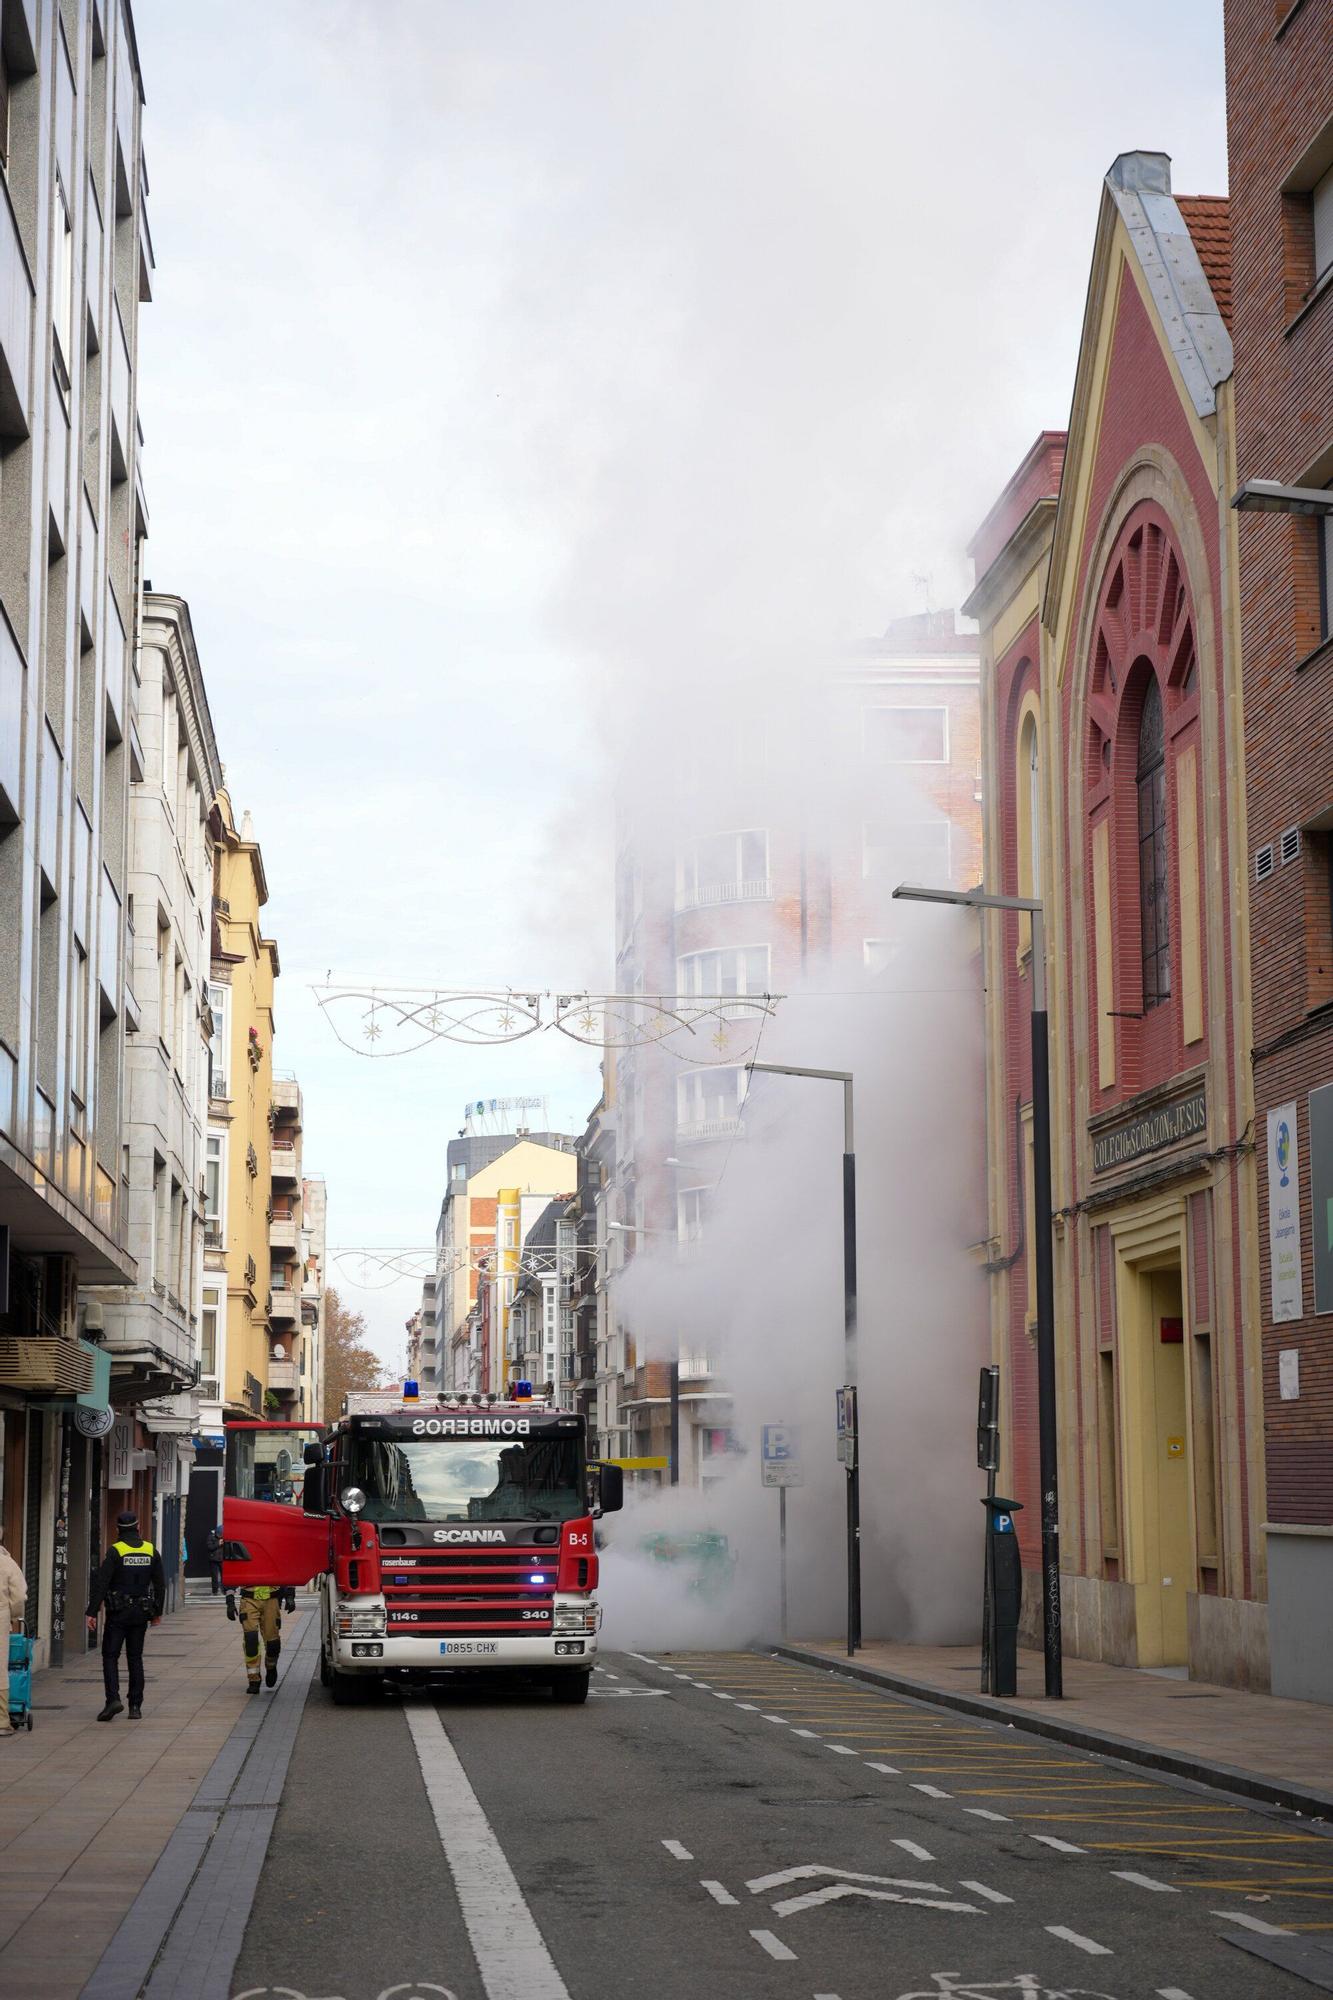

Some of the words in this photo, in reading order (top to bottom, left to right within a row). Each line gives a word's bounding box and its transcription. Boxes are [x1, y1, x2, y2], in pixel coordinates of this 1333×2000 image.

[1094, 1131, 1127, 1168] COLEGIO
[1174, 1097, 1205, 1136] JESUS
[999, 1515, 1010, 1531] P
[433, 1529, 506, 1543] SCANIA
[569, 1533, 588, 1546] B-5
[125, 1557, 150, 1565] POLIZIA
[382, 1557, 417, 1567] rosenbauer
[391, 1612, 418, 1621] 114G
[522, 1610, 549, 1619] 340
[447, 1643, 473, 1653] 0855
[476, 1643, 496, 1653] CHX
